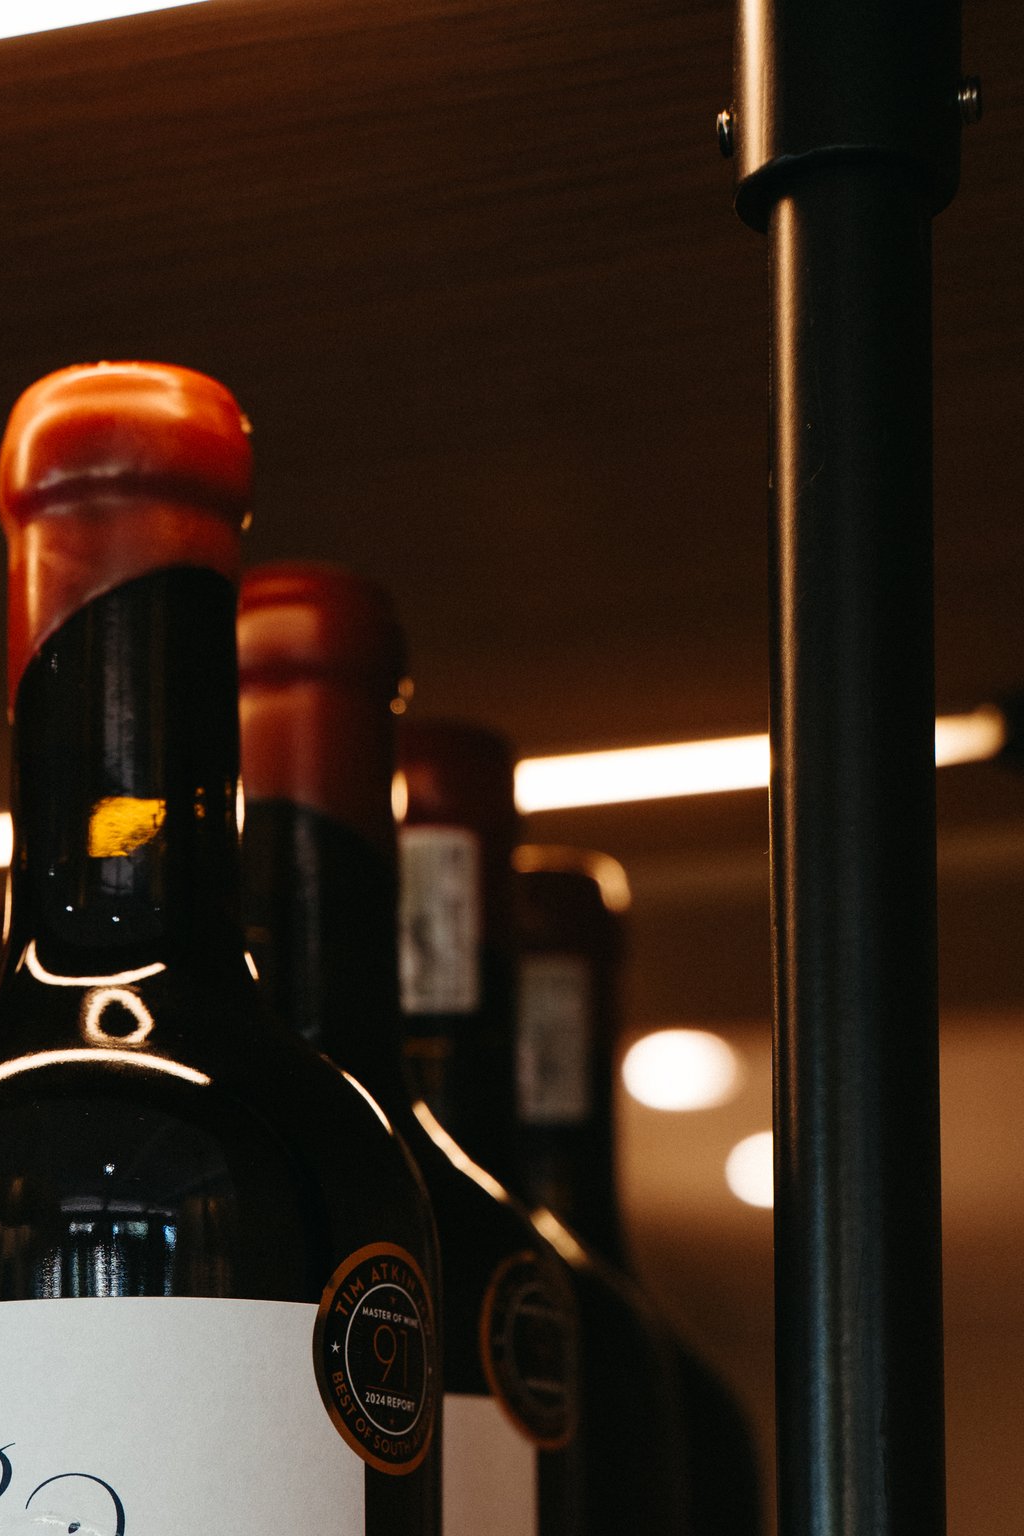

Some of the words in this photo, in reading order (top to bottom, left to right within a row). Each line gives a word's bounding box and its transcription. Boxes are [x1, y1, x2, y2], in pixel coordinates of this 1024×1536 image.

[335, 1278, 364, 1316] TIM
[362, 1306, 391, 1321] MASTER
[393, 1313, 403, 1323] OF
[374, 1324, 408, 1391] 91
[332, 1371, 357, 1416] BEST
[355, 1417, 372, 1441] OF
[365, 1391, 386, 1406] 2024
[386, 1396, 416, 1413] REPORT
